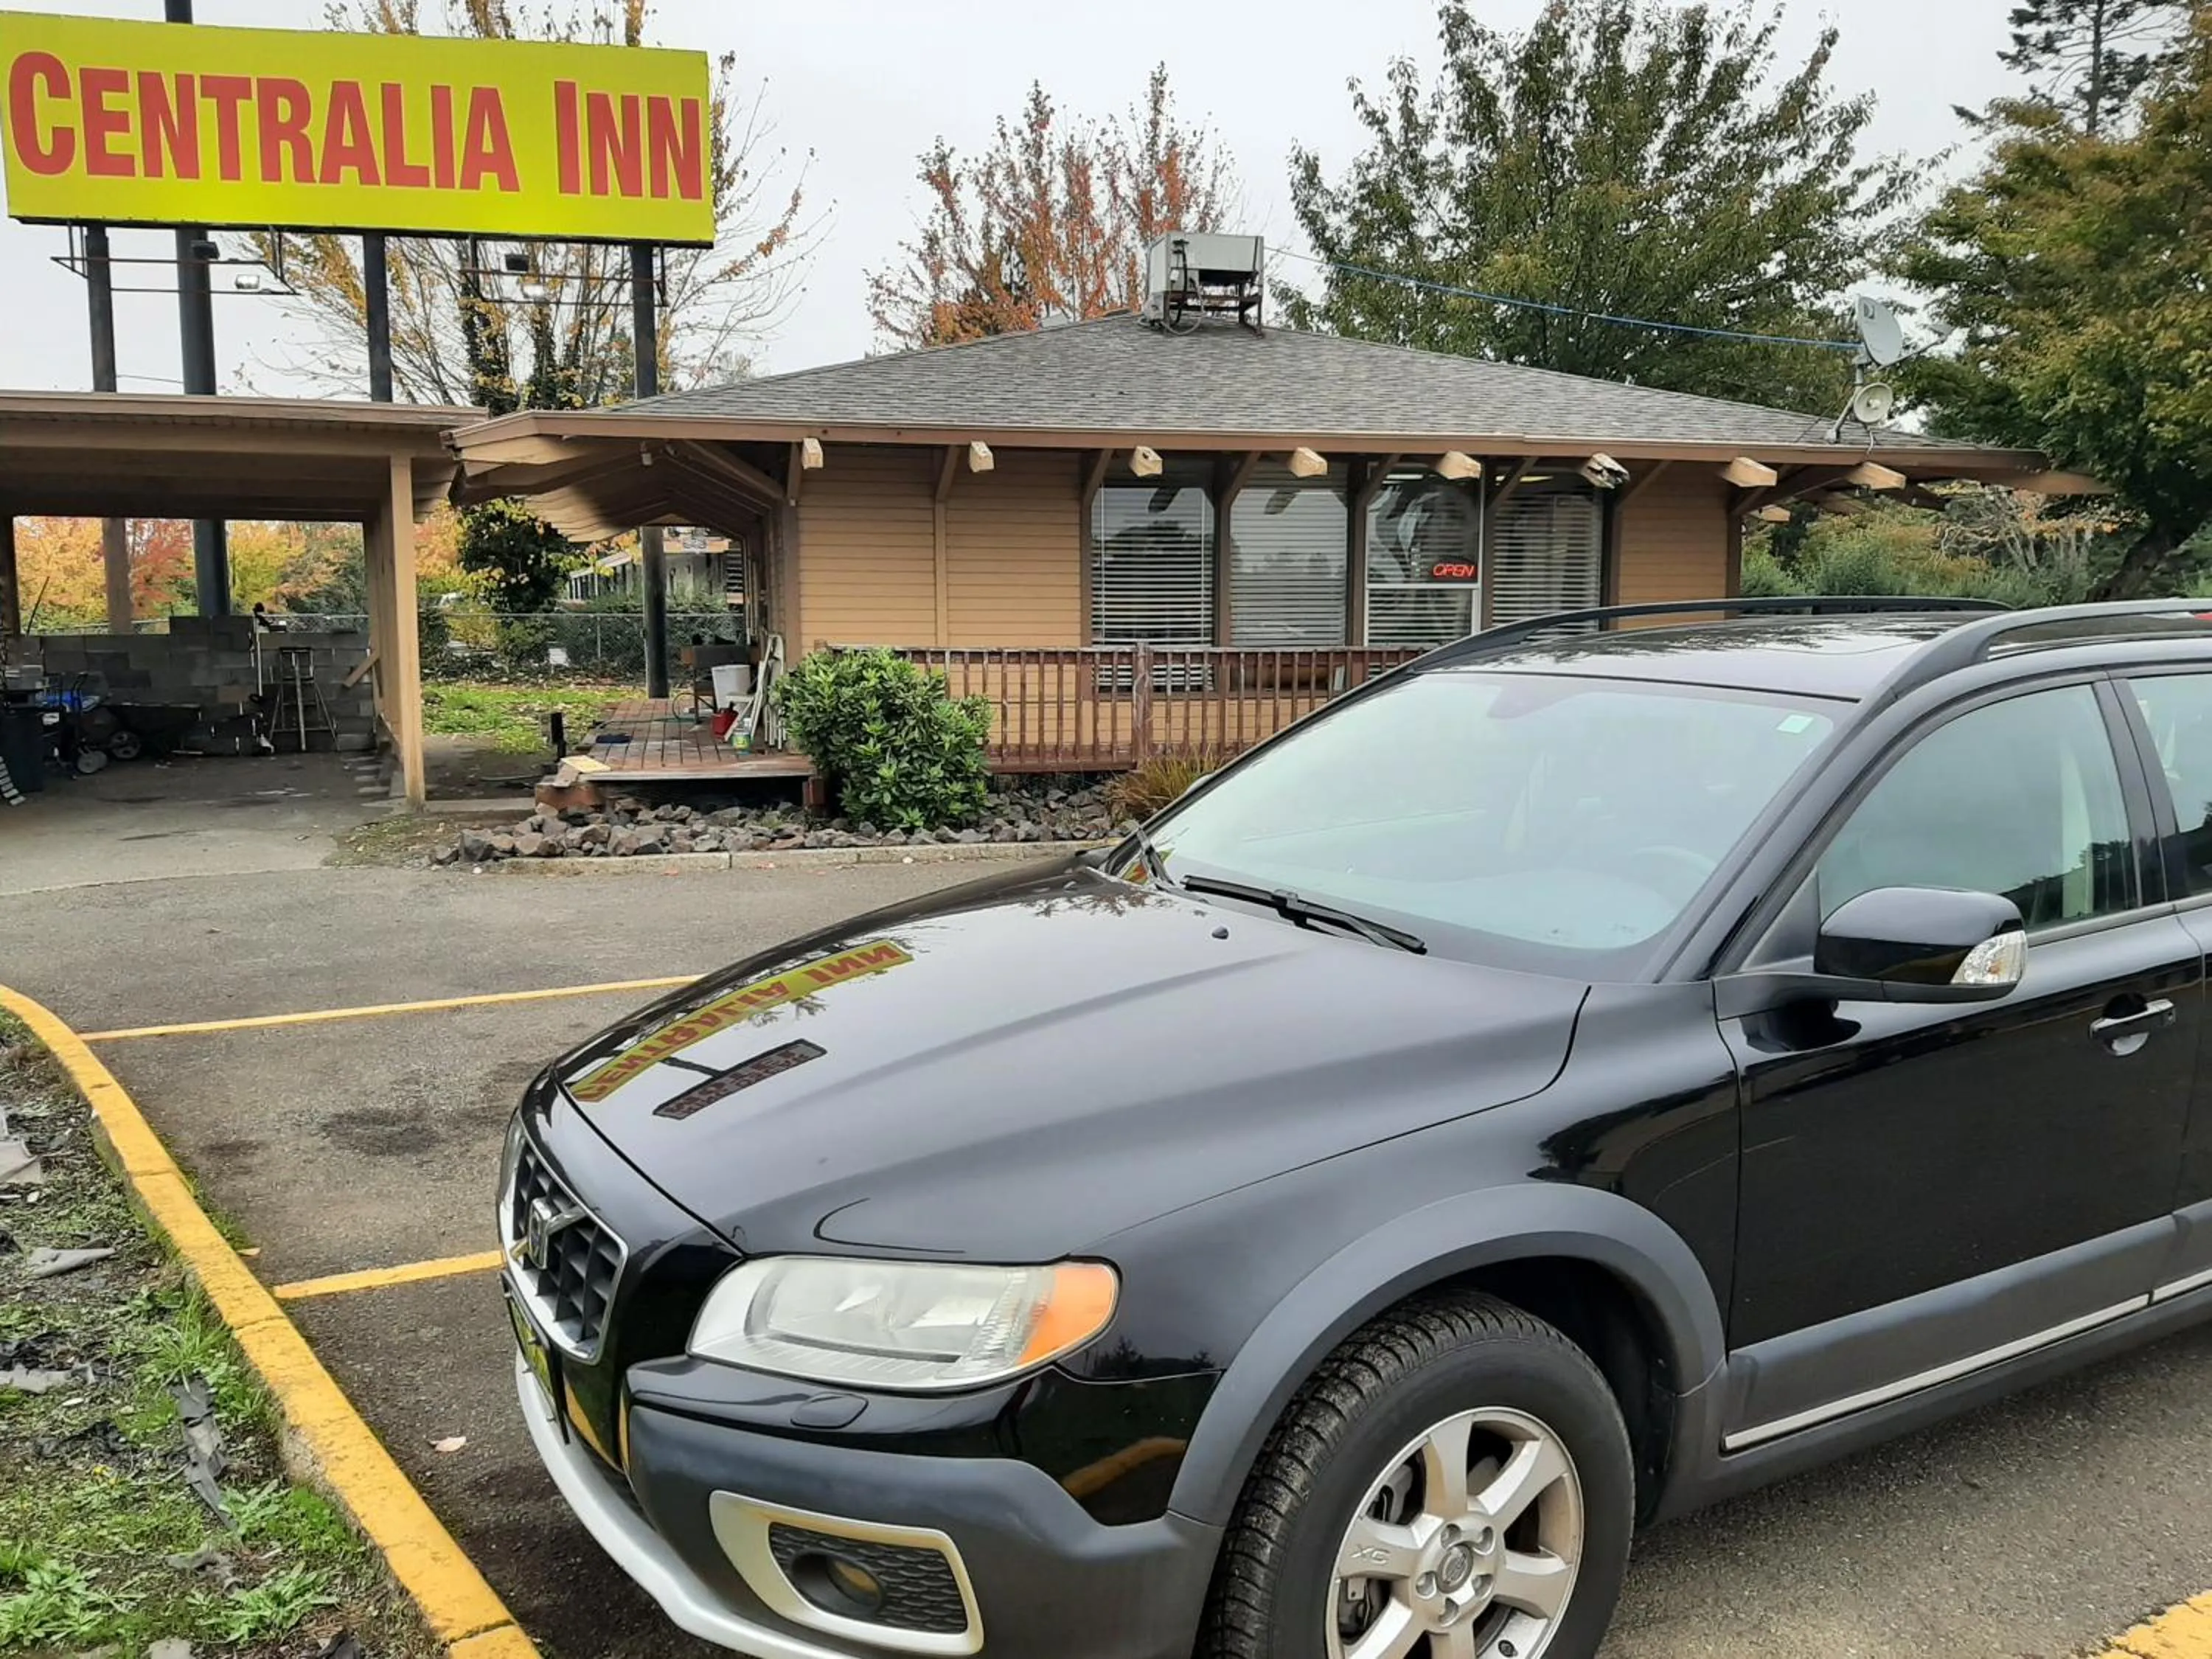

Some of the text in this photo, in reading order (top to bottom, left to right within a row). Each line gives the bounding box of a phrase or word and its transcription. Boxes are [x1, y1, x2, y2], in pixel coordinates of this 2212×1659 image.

[8, 51, 703, 201] CENTRALIA INN
[1433, 563, 1475, 577] OPEN
